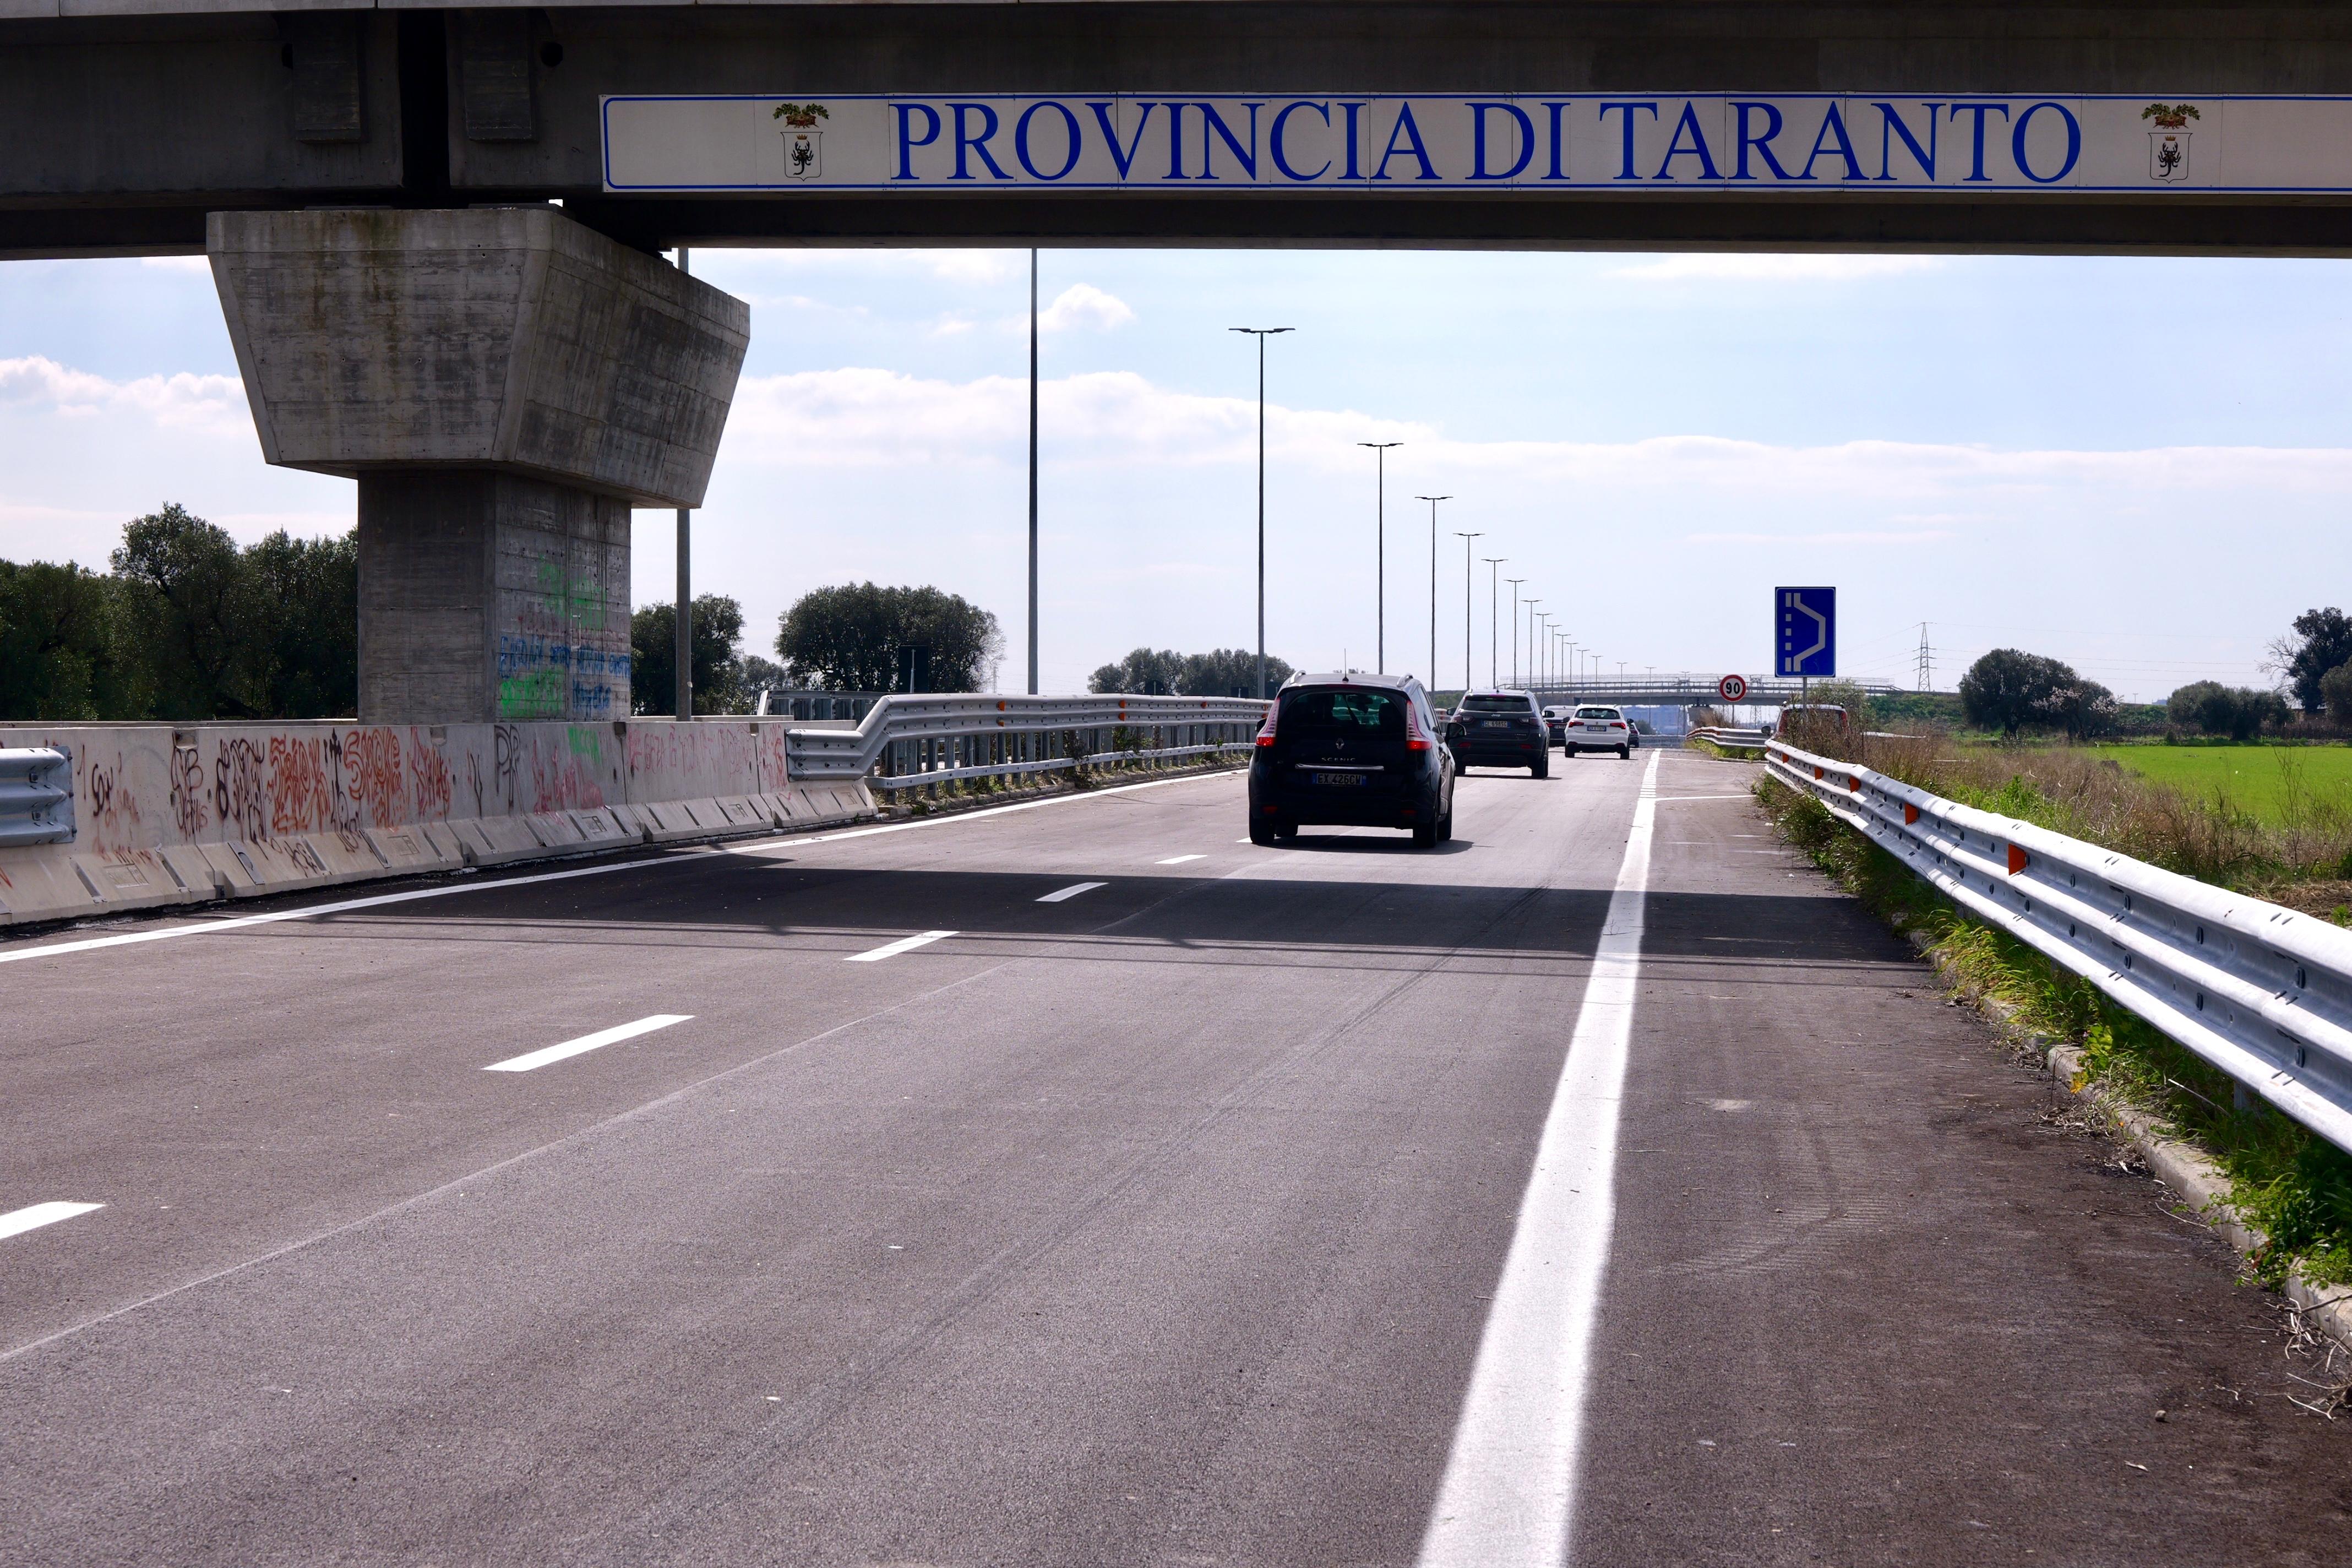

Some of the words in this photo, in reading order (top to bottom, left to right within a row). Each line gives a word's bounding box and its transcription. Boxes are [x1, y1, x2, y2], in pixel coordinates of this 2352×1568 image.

[889, 101, 1442, 180] PROVINCIA
[1464, 102, 1571, 180] DI
[1599, 102, 2081, 183] TARANTO
[1725, 682, 1740, 694] 90
